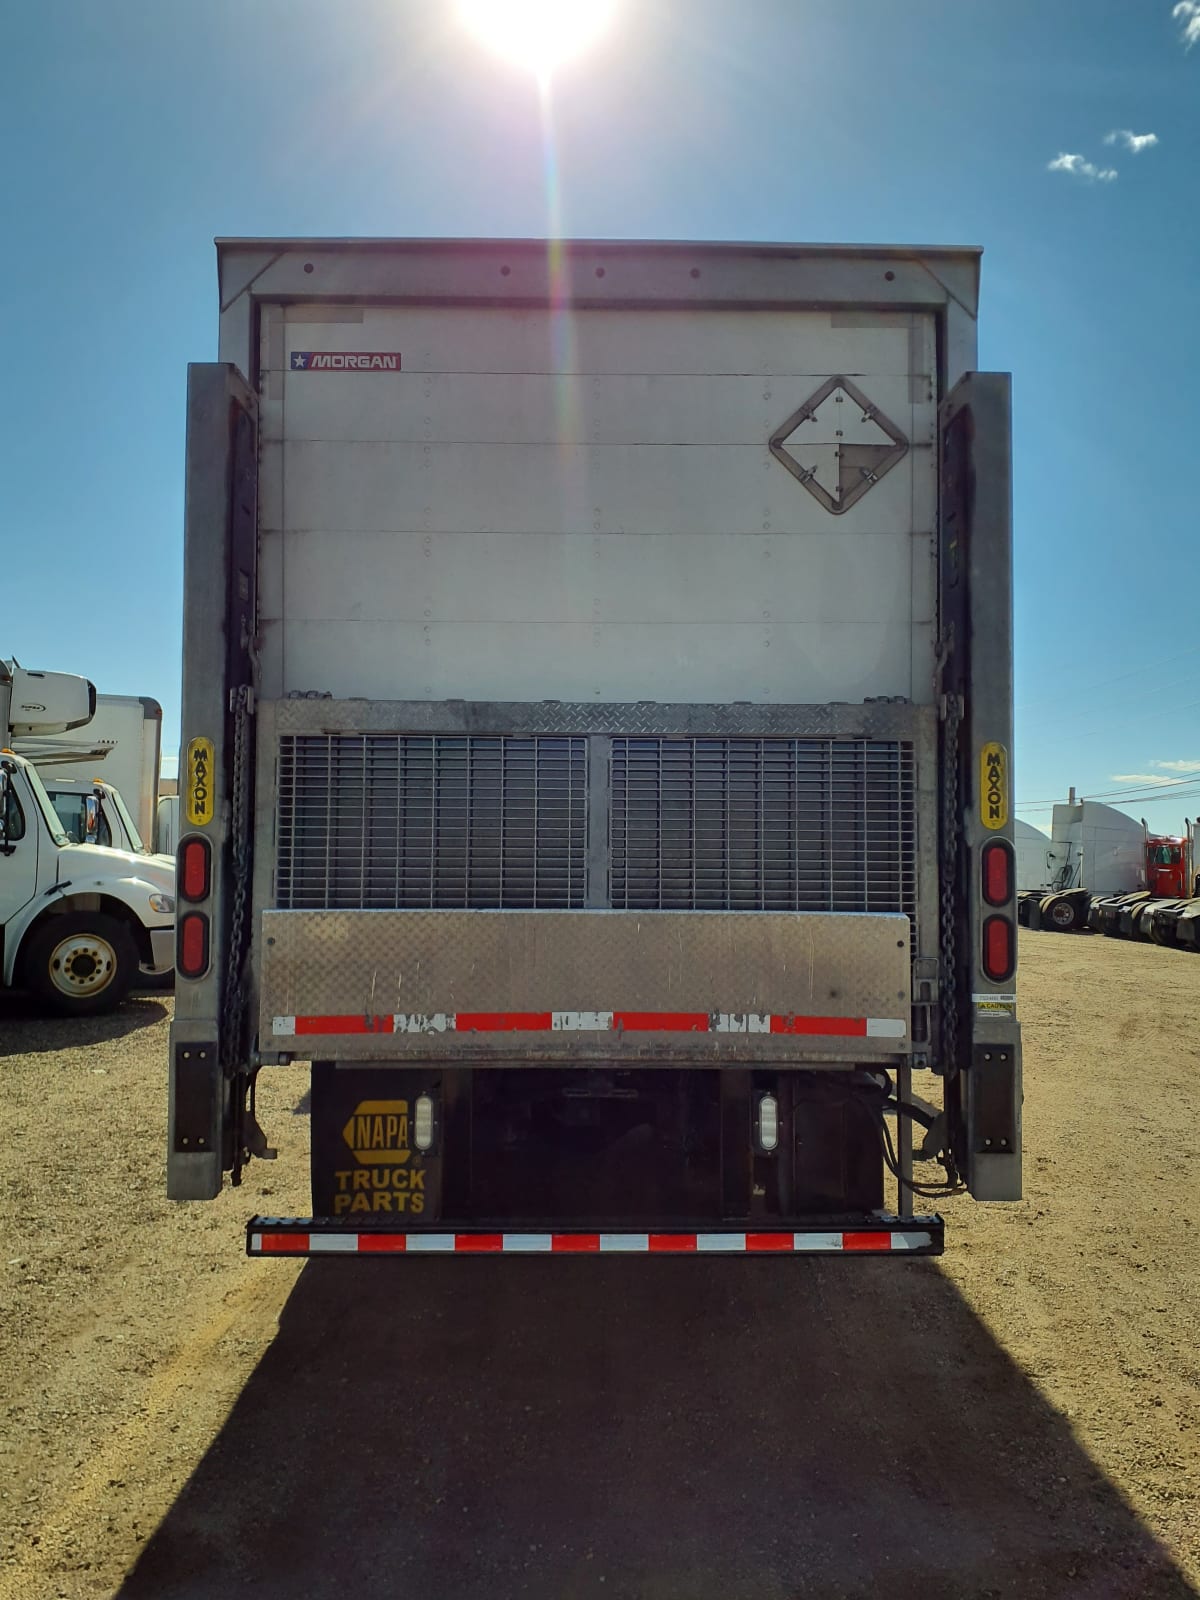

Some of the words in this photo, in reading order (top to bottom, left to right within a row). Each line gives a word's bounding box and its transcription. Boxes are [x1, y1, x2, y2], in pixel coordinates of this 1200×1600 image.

[311, 355, 397, 368] MORGAN
[193, 748, 208, 815] MAXON
[987, 753, 1001, 819] MAXON
[357, 1115, 408, 1149] NAPA
[335, 1169, 426, 1190] TRUCK
[334, 1192, 425, 1214] PARTS
